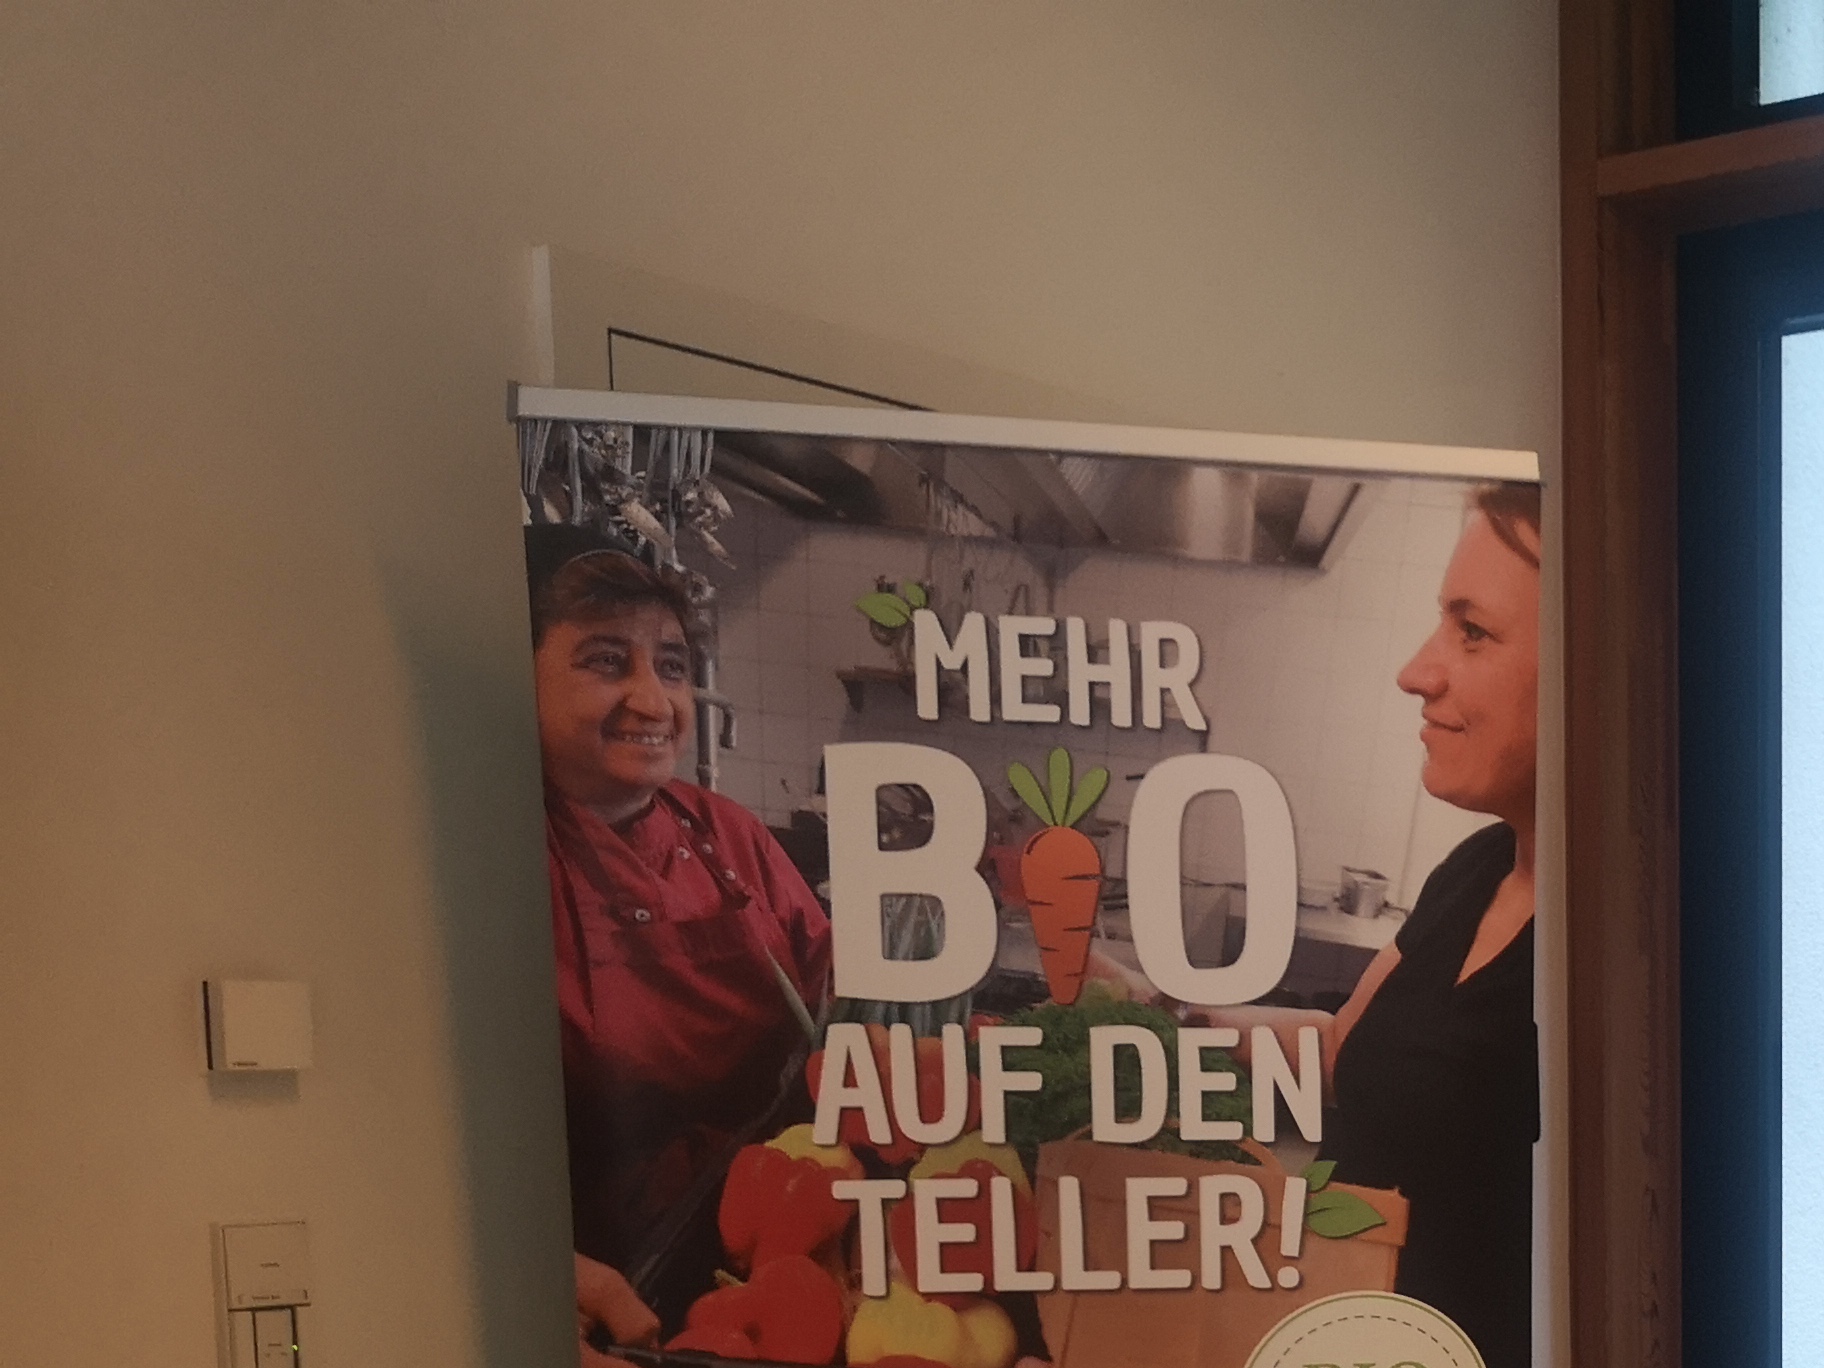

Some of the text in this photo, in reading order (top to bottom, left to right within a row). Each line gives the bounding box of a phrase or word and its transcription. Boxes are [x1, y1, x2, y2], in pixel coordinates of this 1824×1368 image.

[912, 608, 1207, 731] MEHR
[810, 1023, 1322, 1146] AUF DEN
[832, 1174, 1311, 1298] TELLER!
